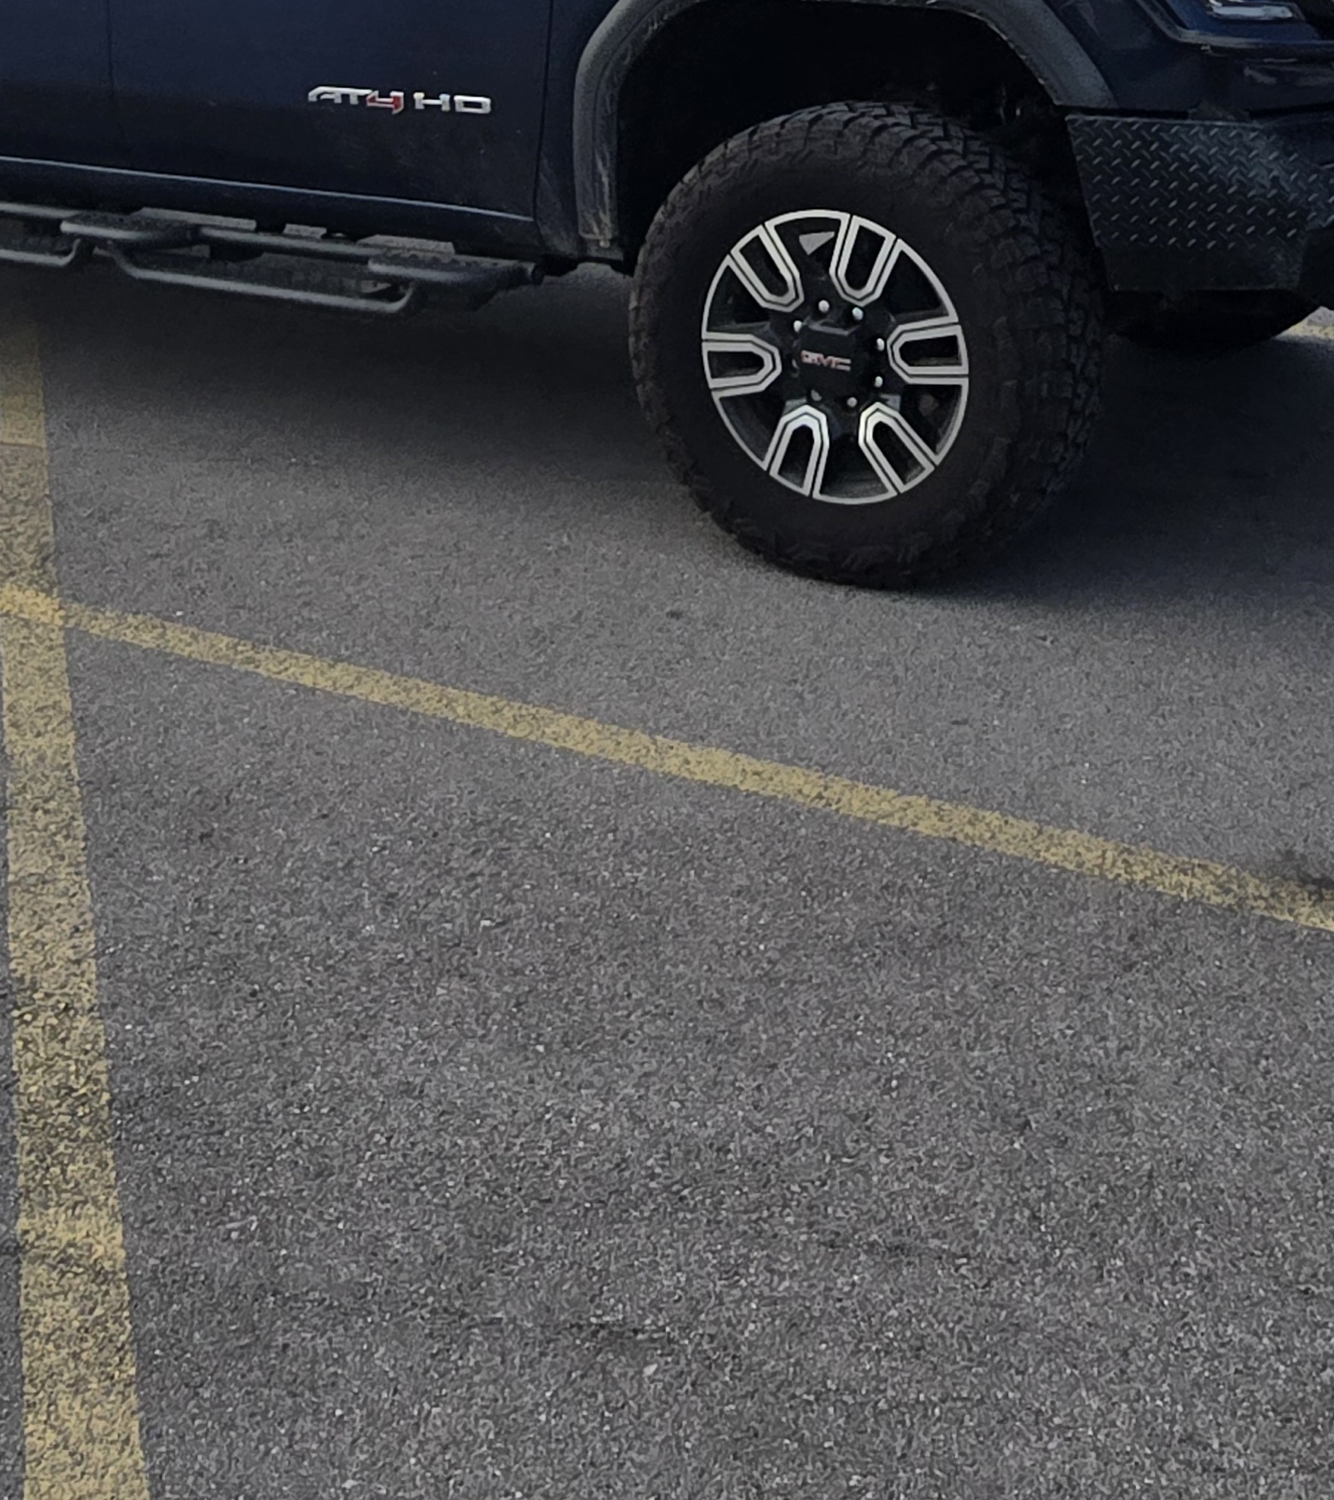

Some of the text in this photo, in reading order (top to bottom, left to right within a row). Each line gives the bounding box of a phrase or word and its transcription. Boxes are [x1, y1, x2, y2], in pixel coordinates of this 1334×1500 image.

[307, 85, 492, 114] AT4 HD
[800, 350, 852, 371] GMC
